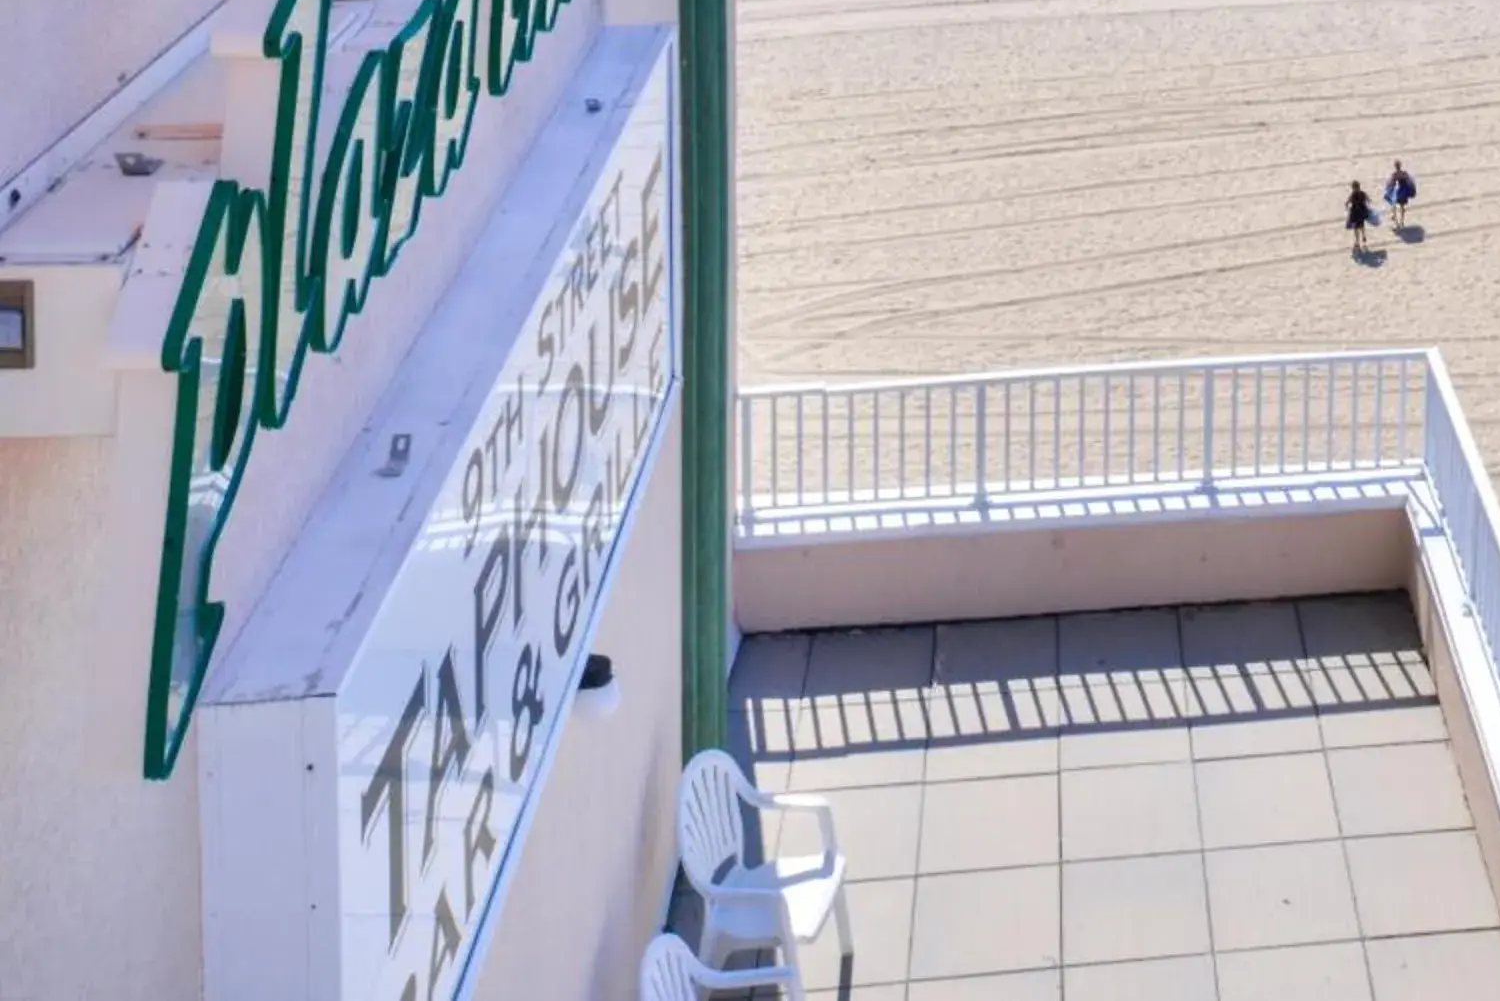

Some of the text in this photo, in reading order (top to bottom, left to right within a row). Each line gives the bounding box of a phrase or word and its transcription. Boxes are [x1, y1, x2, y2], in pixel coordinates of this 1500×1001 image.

[361, 148, 662, 959] TAPHOUSE
[399, 320, 664, 1000] AR & GRILLE
[463, 169, 625, 558] 9TH STREET
